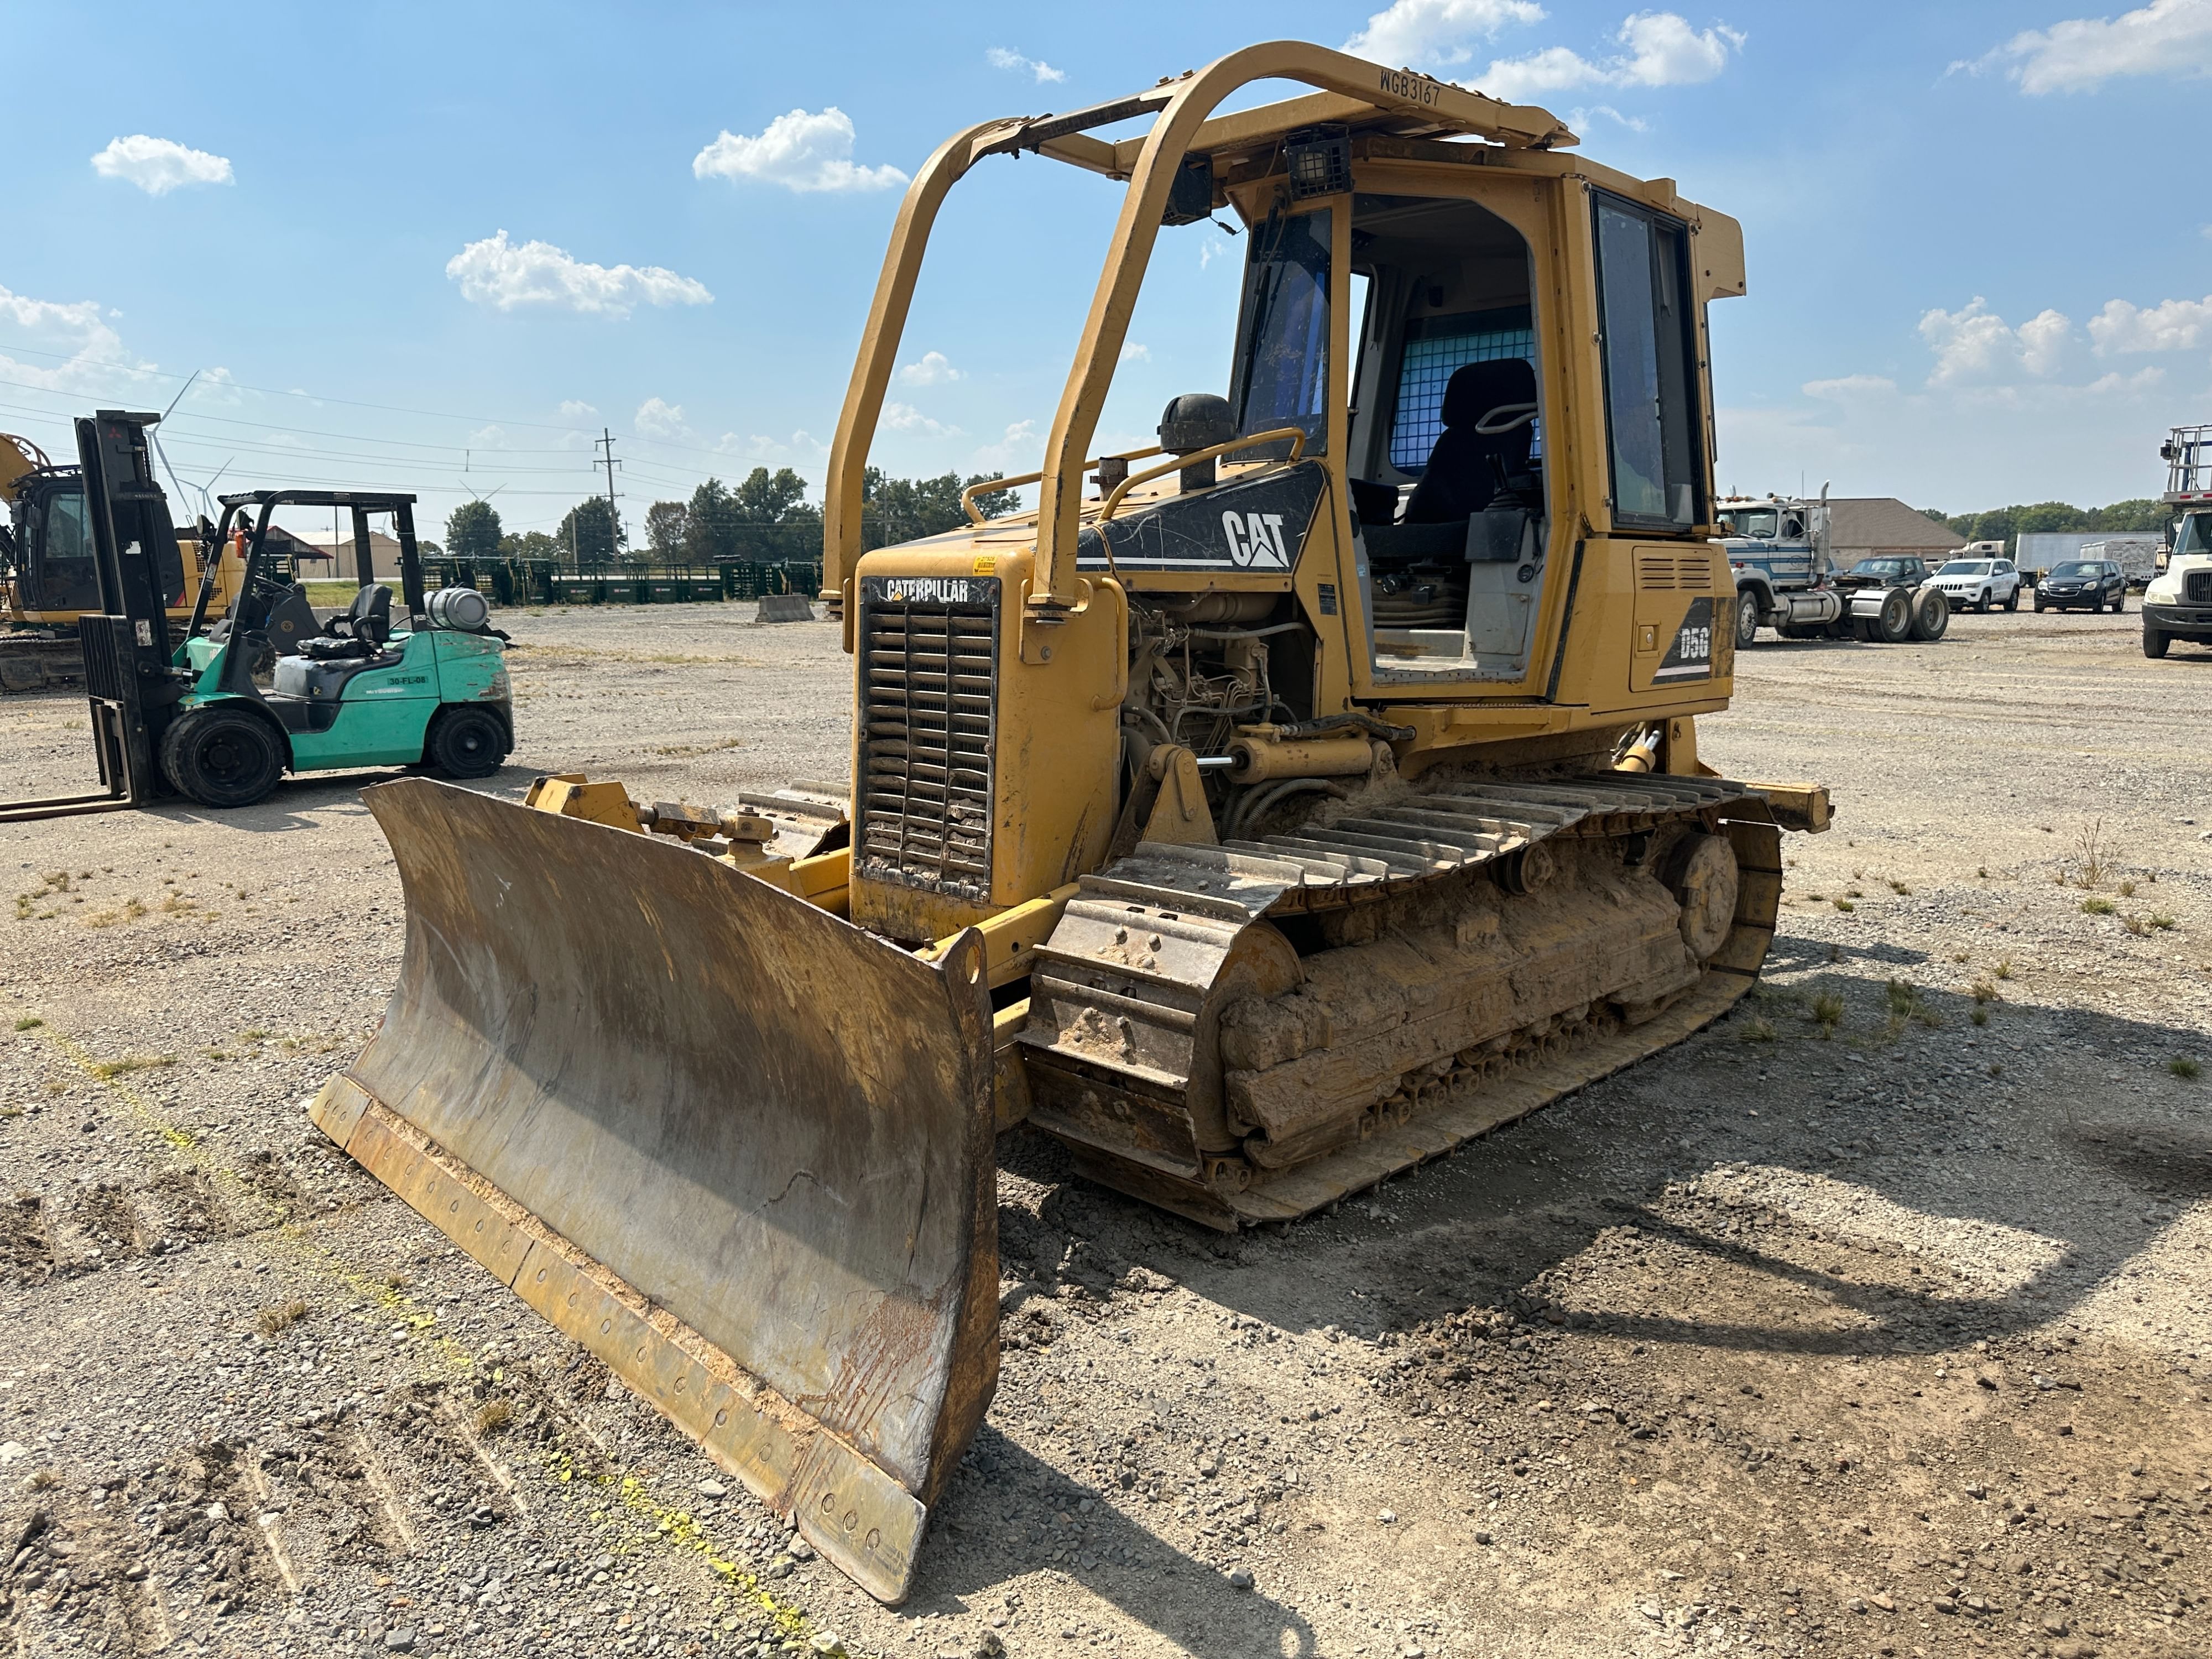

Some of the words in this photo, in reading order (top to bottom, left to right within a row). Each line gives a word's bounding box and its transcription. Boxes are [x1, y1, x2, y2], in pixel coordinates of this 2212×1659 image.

[1380, 69, 1440, 107] WGB3167
[1222, 510, 1290, 567] CAT
[887, 579, 968, 603] CATERPILLAR
[1681, 627, 1709, 659] D5G
[389, 676, 426, 685] 30-FL-08
